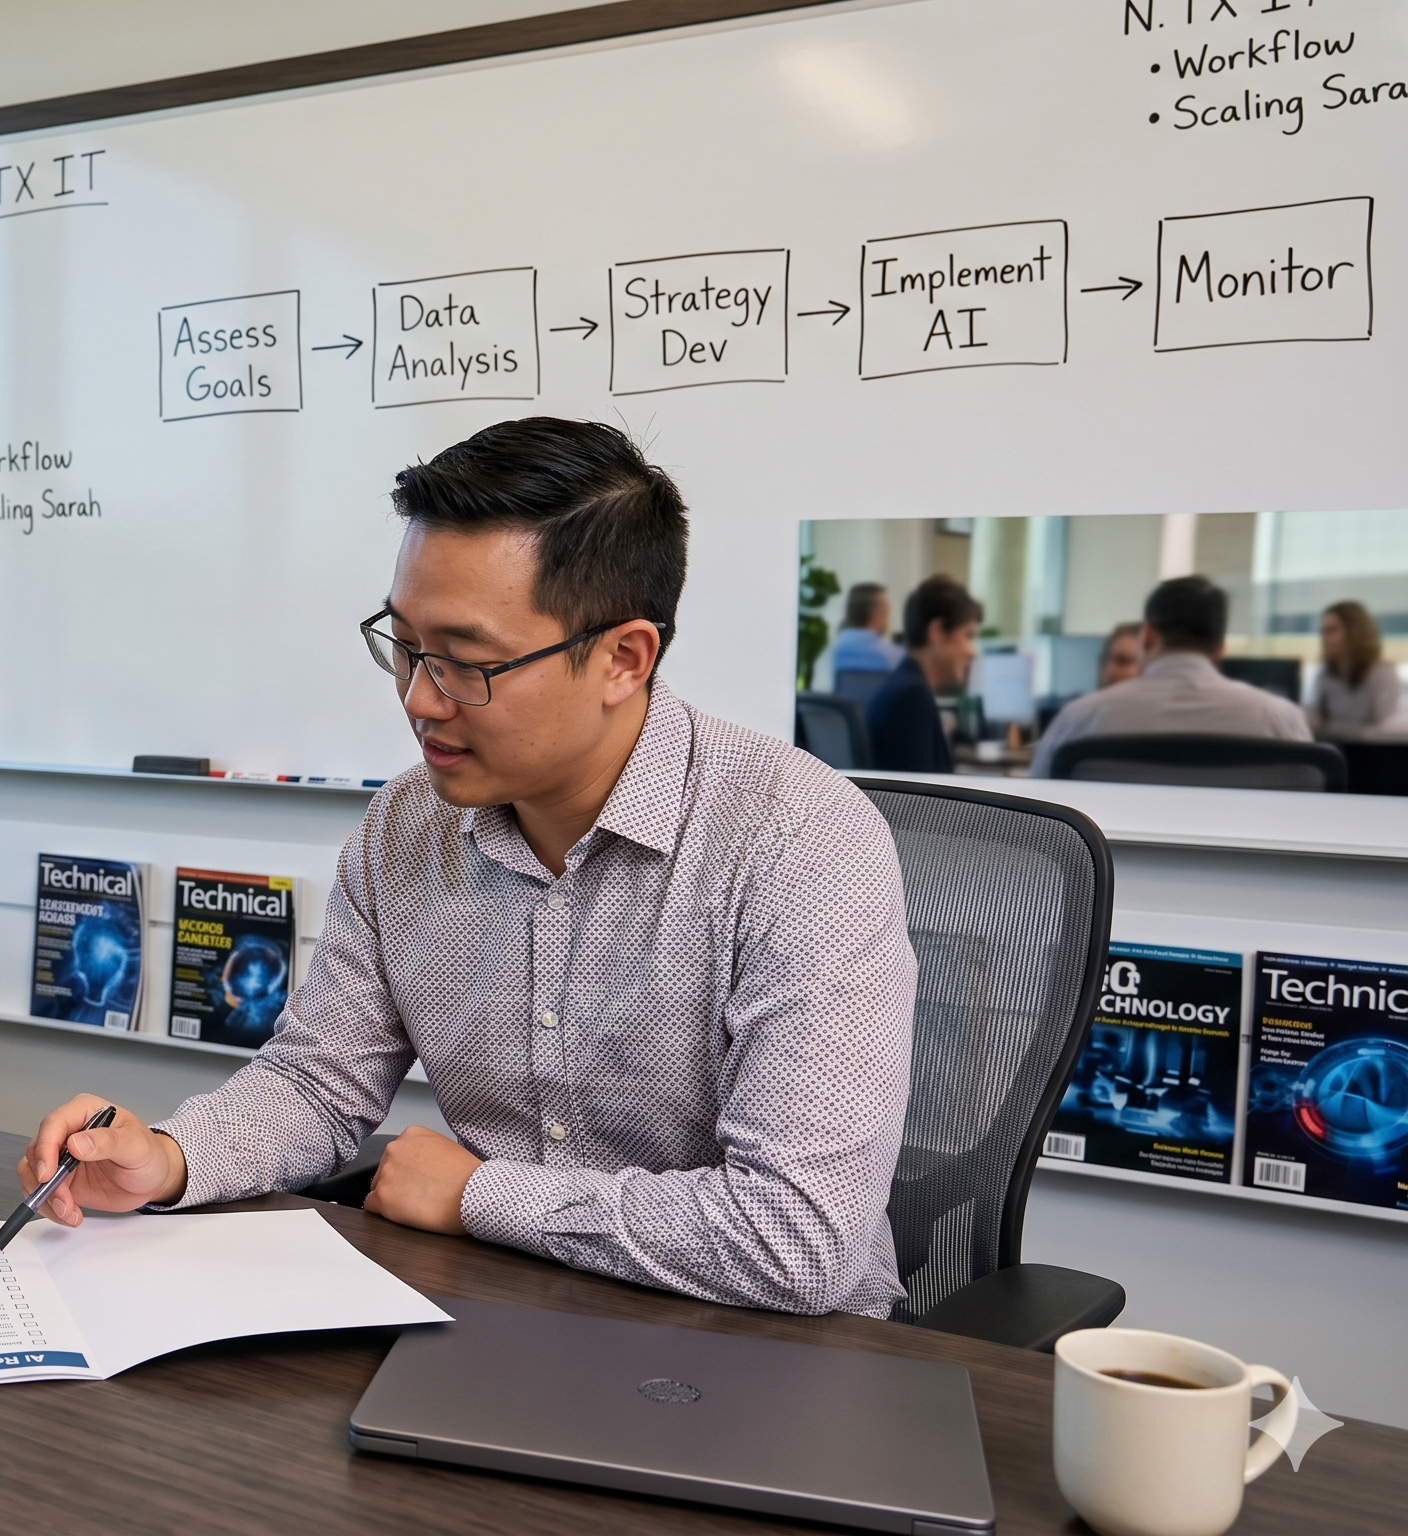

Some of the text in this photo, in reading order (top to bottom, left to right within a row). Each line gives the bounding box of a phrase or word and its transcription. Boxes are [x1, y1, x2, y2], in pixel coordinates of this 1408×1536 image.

[1173, 29, 1355, 80] Workflow
[1173, 89, 1304, 136] Scaling
[52, 149, 106, 198] IT
[870, 244, 1053, 304] Implement
[1175, 246, 1356, 303] Monitor
[398, 291, 481, 332] Data
[624, 275, 773, 328] Strategy
[172, 316, 278, 357] Assess
[661, 328, 728, 366] Dev
[922, 307, 989, 352] AI
[185, 364, 272, 401] Goals
[387, 341, 519, 391] Analysis
[40, 488, 102, 521] Sarah
[40, 862, 132, 896] Technical
[178, 880, 287, 918] Technical
[1097, 994, 1231, 1025] CHNOLOGY
[1261, 967, 1408, 1013] Technic
[24, 1353, 45, 1363] AI
